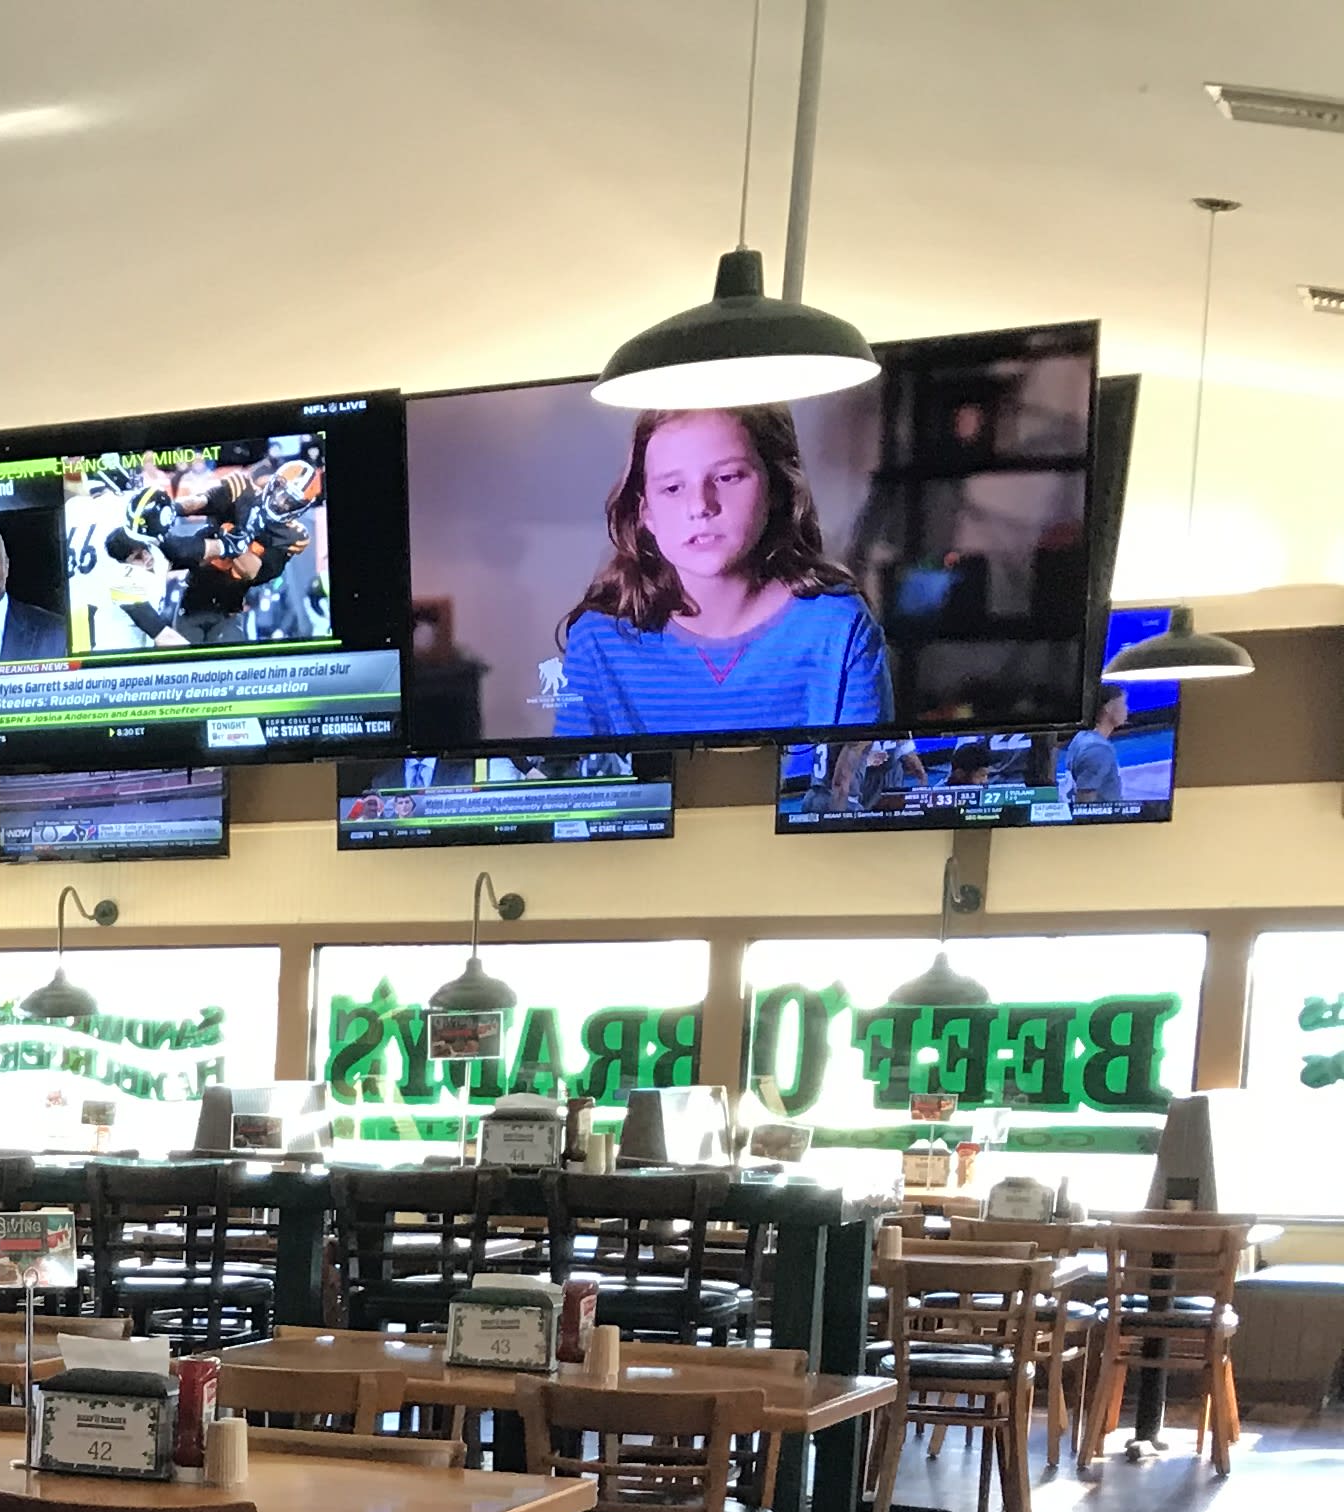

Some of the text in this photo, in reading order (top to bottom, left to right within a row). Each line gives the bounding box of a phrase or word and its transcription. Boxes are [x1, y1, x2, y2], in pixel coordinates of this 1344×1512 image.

[303, 400, 367, 415] NFL LIVE
[122, 446, 222, 468] MY MIND AT
[40, 661, 69, 673] NEWS
[24, 680, 61, 694] Garrett
[63, 677, 83, 690] said
[85, 677, 117, 693] during
[119, 674, 153, 690] appeal
[154, 673, 189, 686] Mason
[191, 669, 234, 685] Rudolph
[235, 667, 266, 681] called
[268, 664, 287, 679] him
[289, 668, 296, 678] a
[298, 662, 328, 677] racial
[329, 662, 351, 676] slur
[50, 692, 101, 707] Rudolph
[103, 688, 183, 704] "vehemently
[185, 684, 234, 699] denies"
[236, 681, 309, 696] accusation
[0, 703, 233, 725] ESPN's Josina Anderson and Adam Schefter report
[211, 720, 247, 731] TONIGHT
[288, 716, 321, 725] COLLEGE
[324, 714, 364, 724] FOOTBALL
[134, 726, 145, 737] ET
[265, 726, 279, 738] NC
[281, 724, 310, 737] STATE
[321, 722, 363, 736] GEORGIA
[365, 720, 391, 733] TECH
[813, 743, 828, 779] 3
[573, 799, 617, 809] accusation
[936, 794, 953, 806] 33
[984, 792, 1001, 804] 27
[1072, 808, 1113, 816] ARKANSAS
[490, 1338, 511, 1355] 43
[87, 1440, 112, 1461] 42
